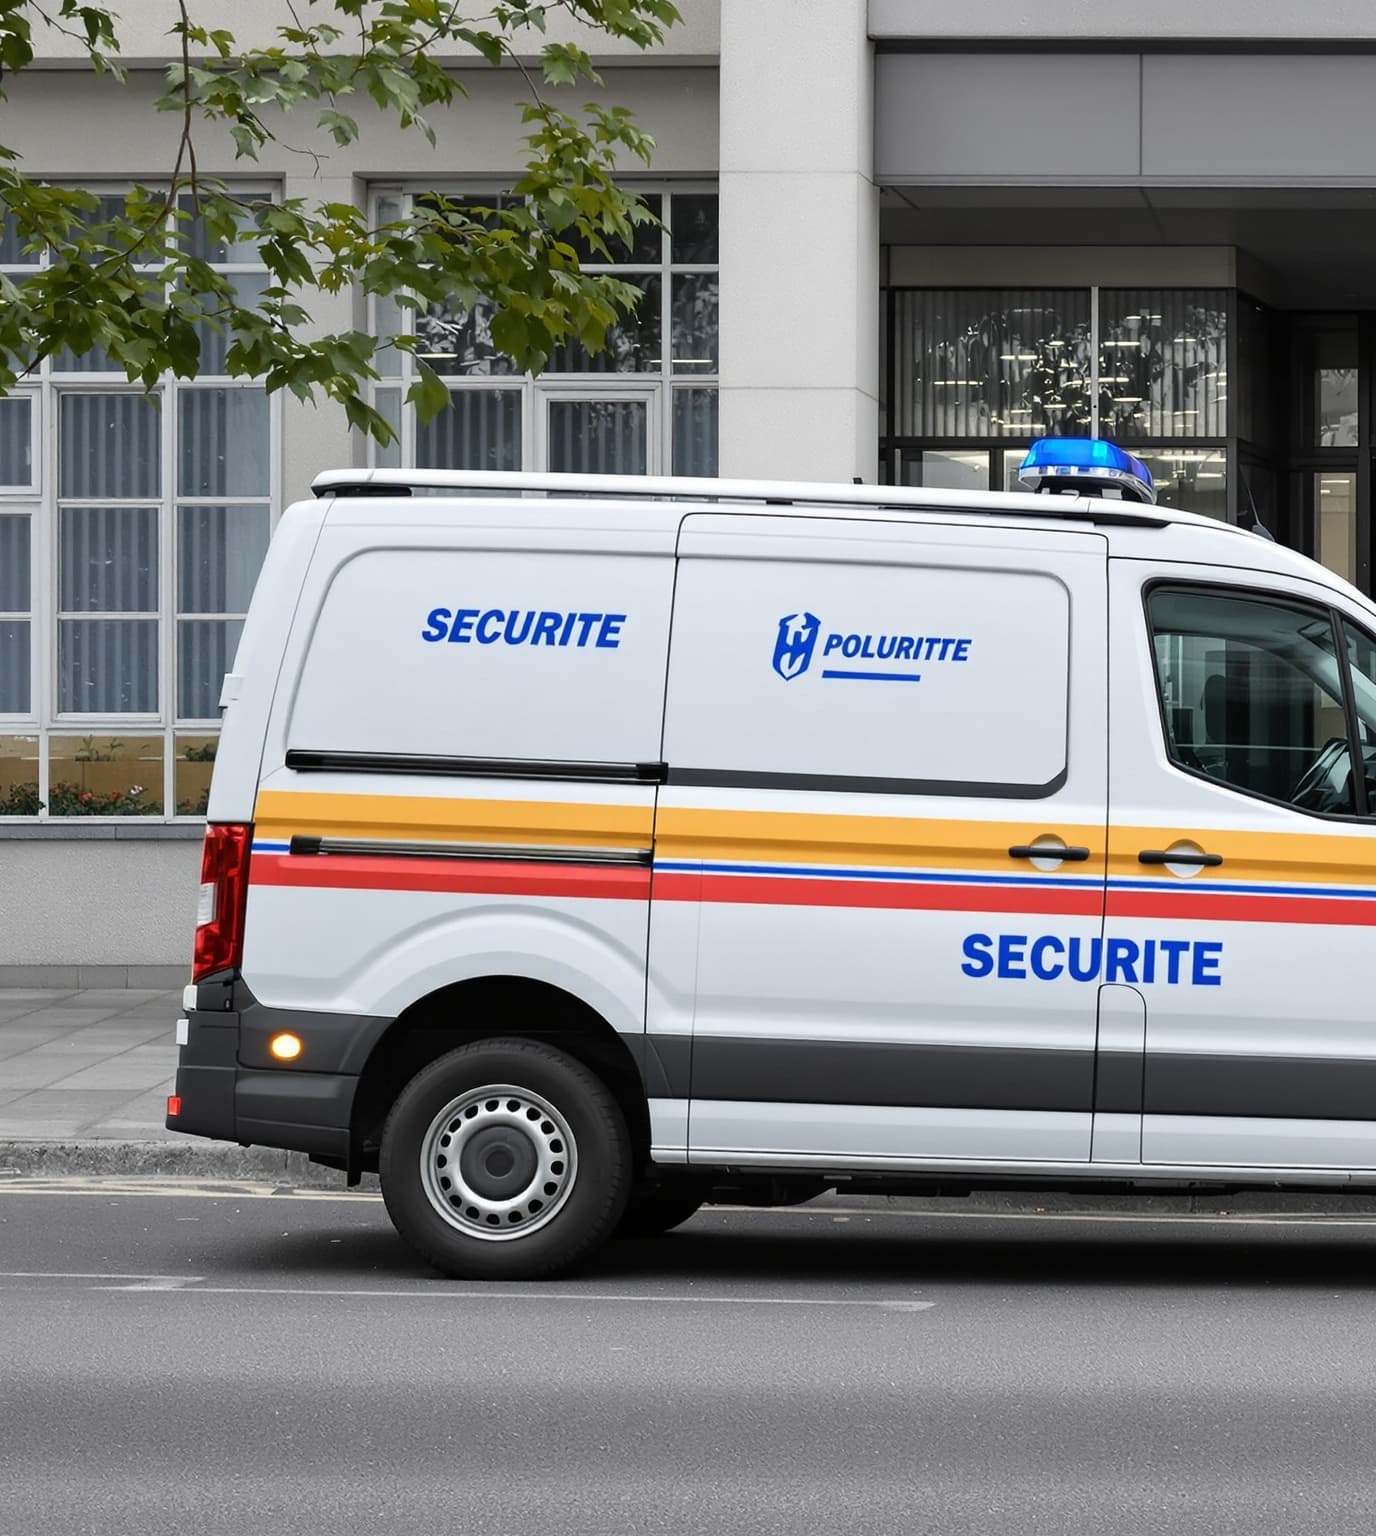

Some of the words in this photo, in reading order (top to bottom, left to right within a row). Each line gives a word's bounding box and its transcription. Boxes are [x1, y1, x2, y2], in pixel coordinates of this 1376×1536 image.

[421, 607, 627, 649] SECURITE
[822, 633, 972, 662] POLURITTE
[960, 932, 1223, 987] SECURITE
